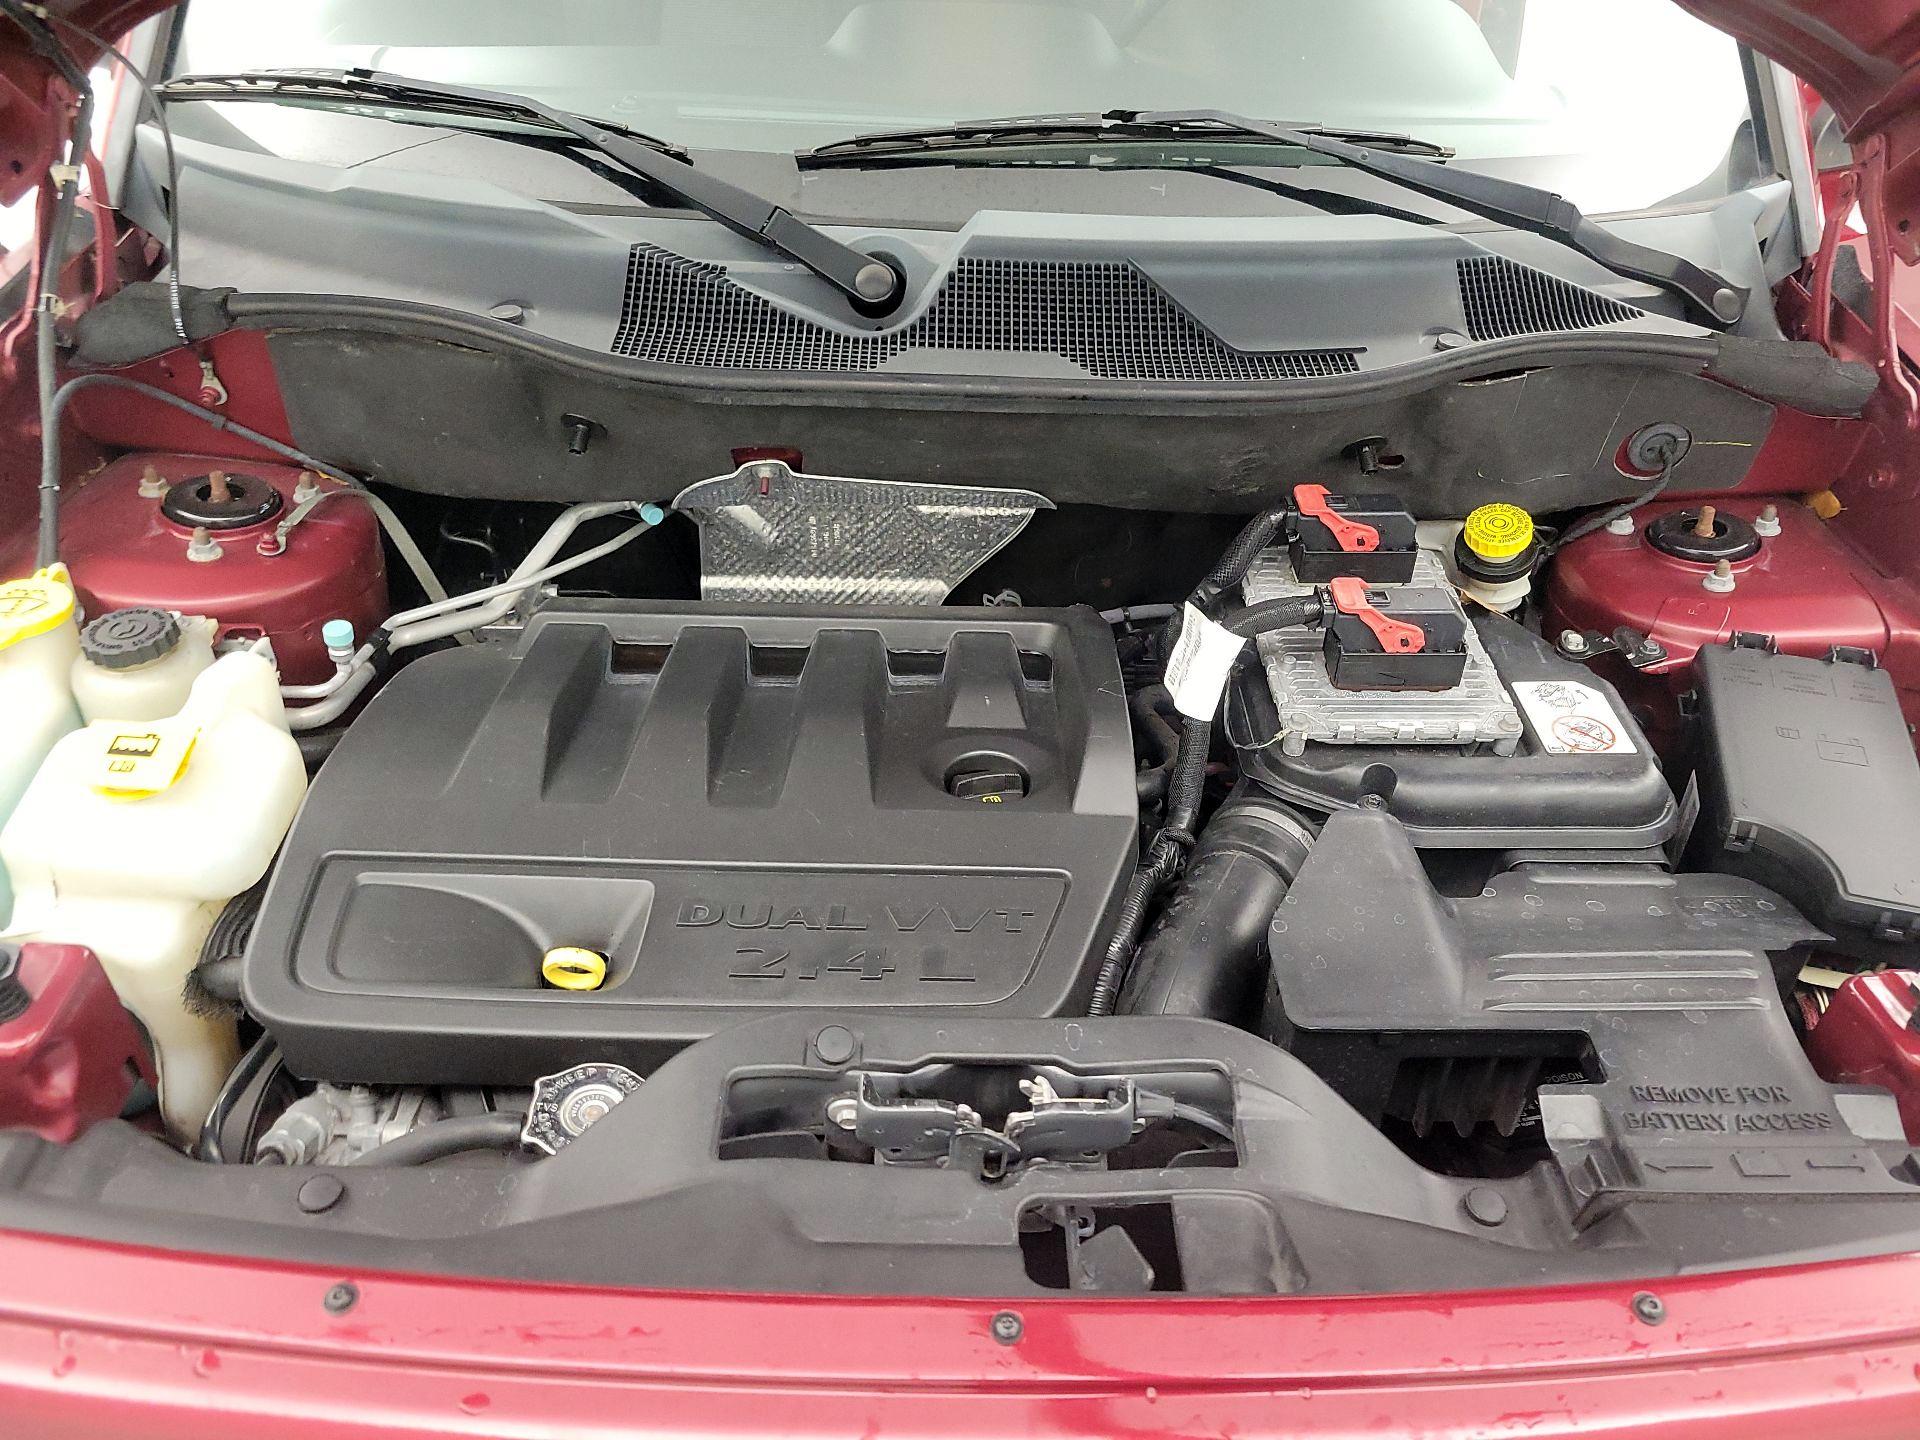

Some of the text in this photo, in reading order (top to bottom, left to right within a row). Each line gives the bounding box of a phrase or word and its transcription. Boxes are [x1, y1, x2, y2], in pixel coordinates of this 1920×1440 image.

[676, 902, 1035, 932] DUAL VVT
[556, 1067, 598, 1089] KEEP
[1544, 1072, 1584, 1084] POISON
[1629, 1085, 1792, 1104] REMOVE FOR
[1622, 1111, 1832, 1132] BATTERY ACCESS
